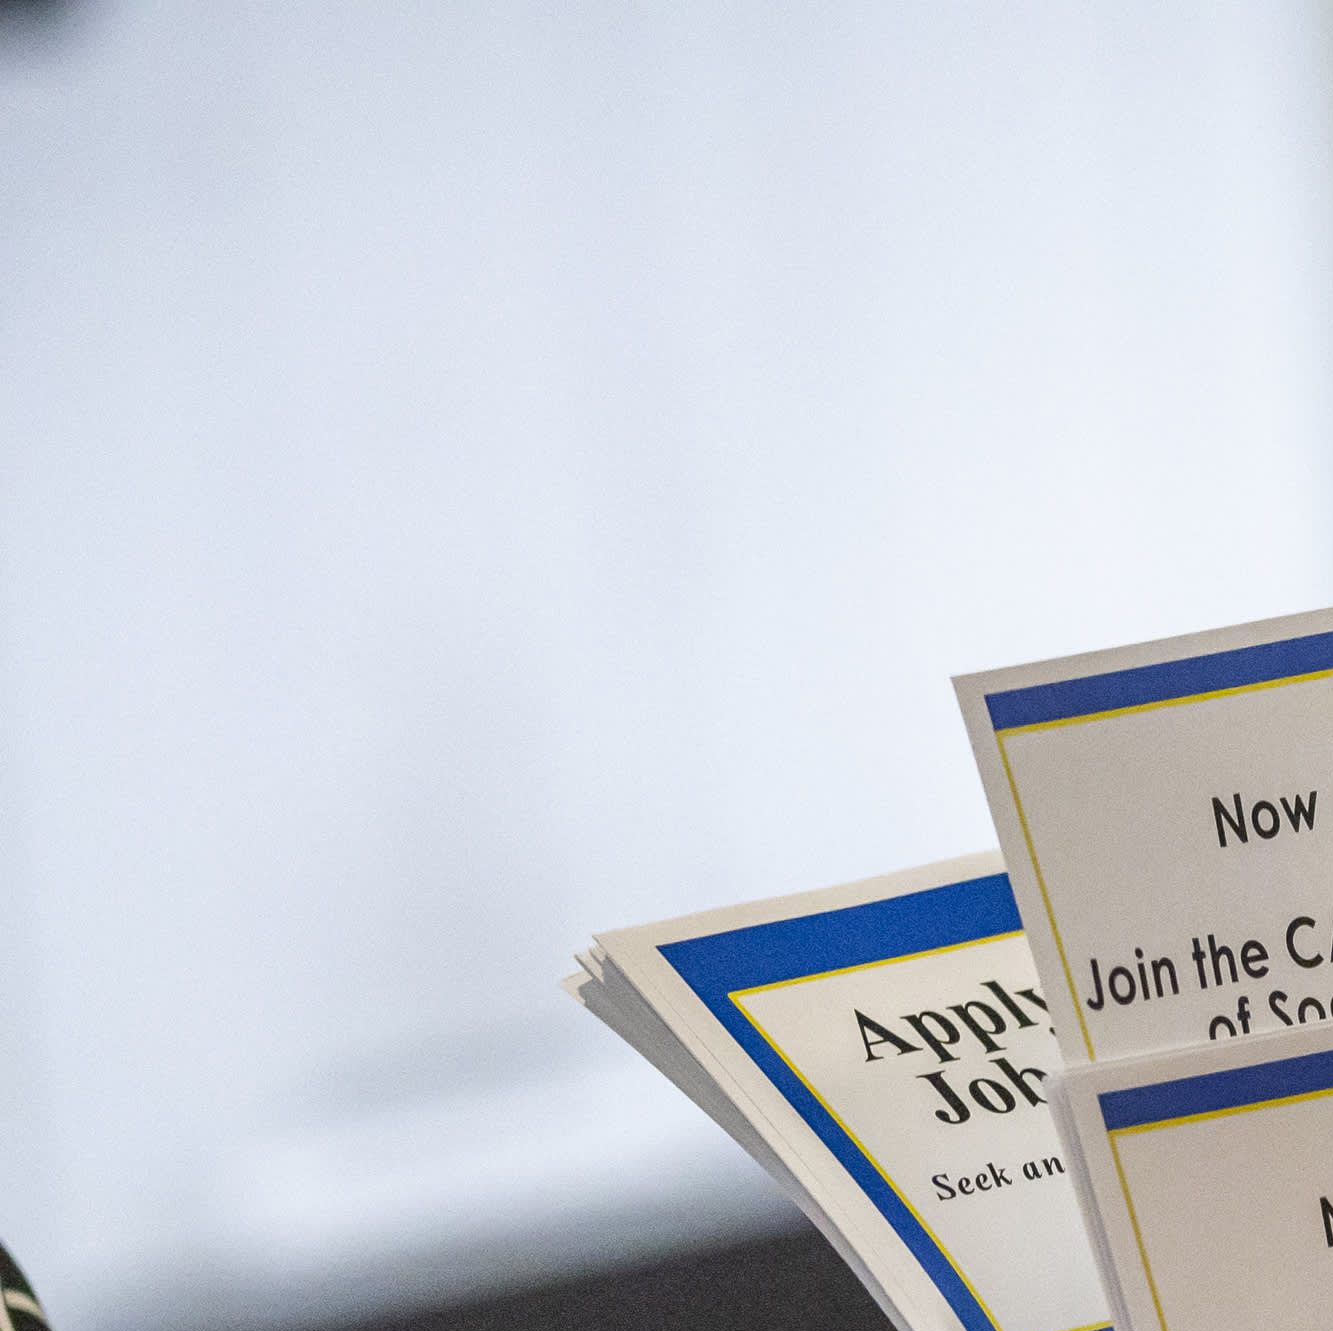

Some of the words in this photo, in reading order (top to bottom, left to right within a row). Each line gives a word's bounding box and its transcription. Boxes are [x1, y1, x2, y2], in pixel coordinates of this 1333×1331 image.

[1212, 790, 1318, 848] Now
[1086, 947, 1181, 1011] Join
[1192, 934, 1270, 990] the
[931, 1162, 1013, 1201] Seek
